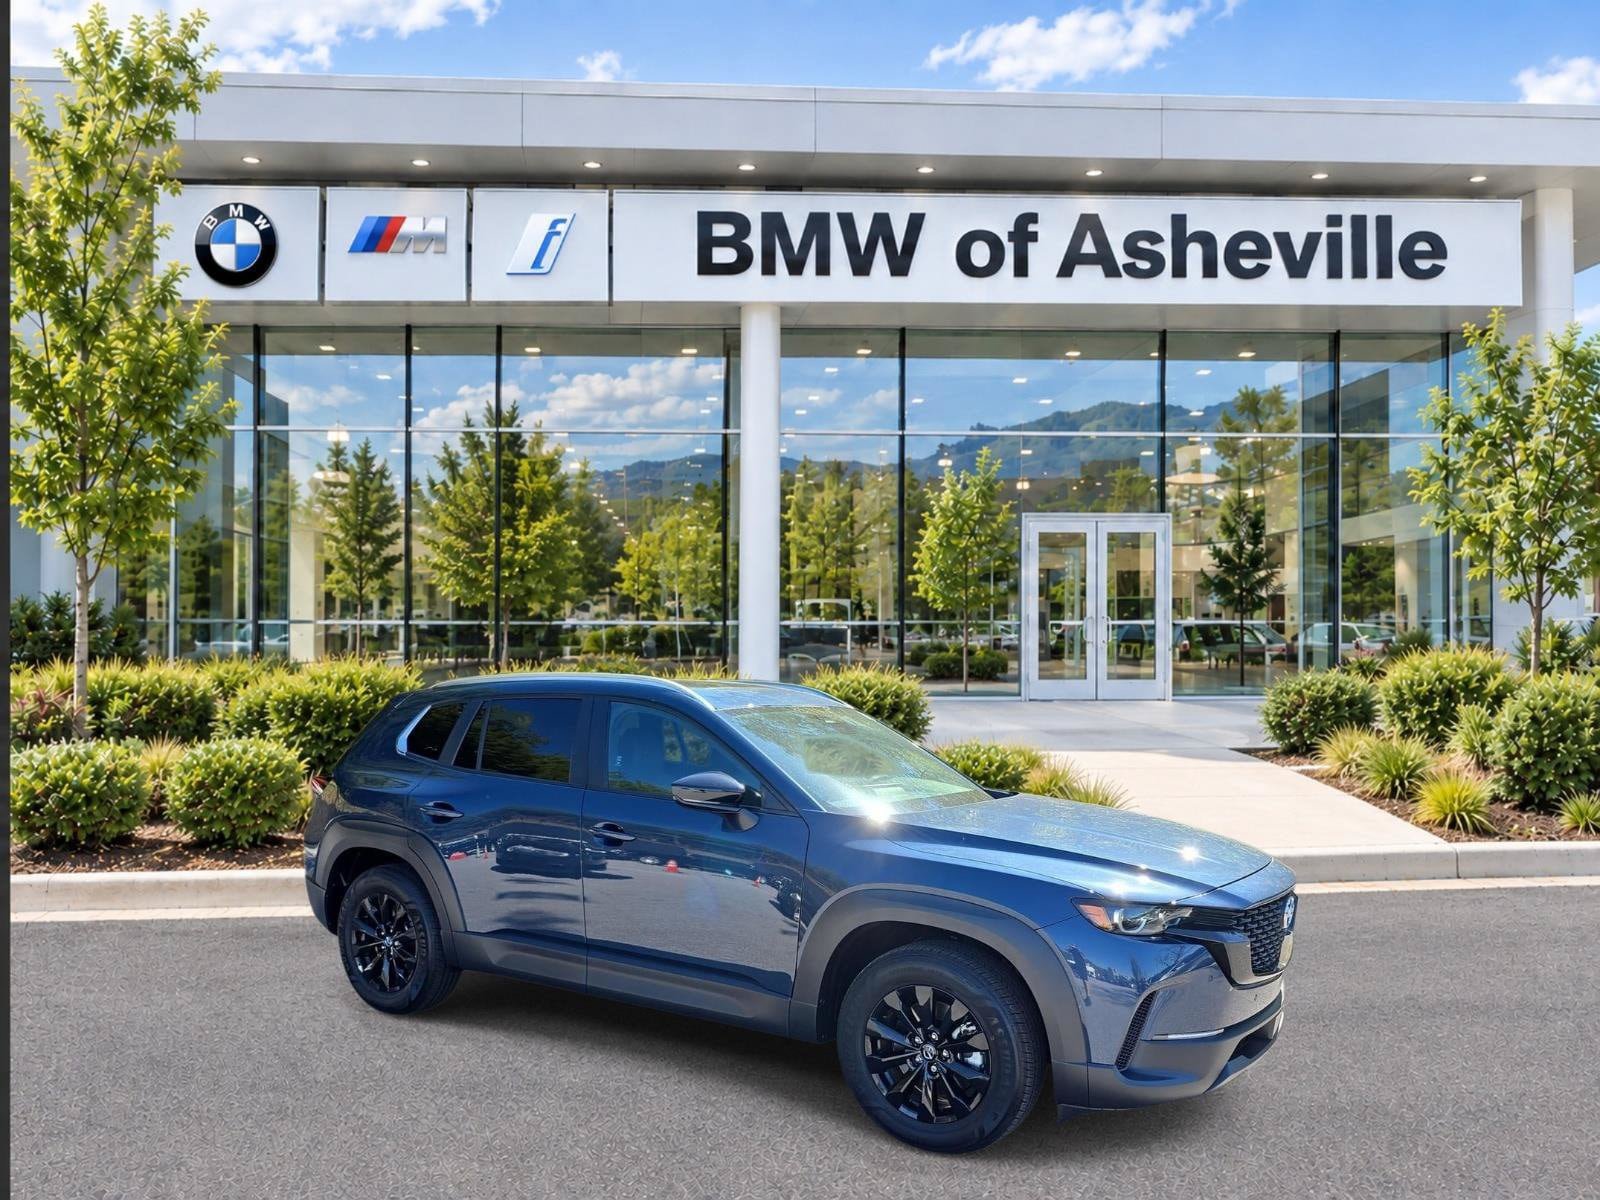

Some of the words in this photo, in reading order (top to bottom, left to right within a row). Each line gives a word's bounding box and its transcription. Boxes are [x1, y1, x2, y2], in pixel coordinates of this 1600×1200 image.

[203, 204, 271, 231] BMW
[696, 209, 926, 277] BMW
[955, 212, 1039, 278] of
[1056, 213, 1448, 280] Asheville
